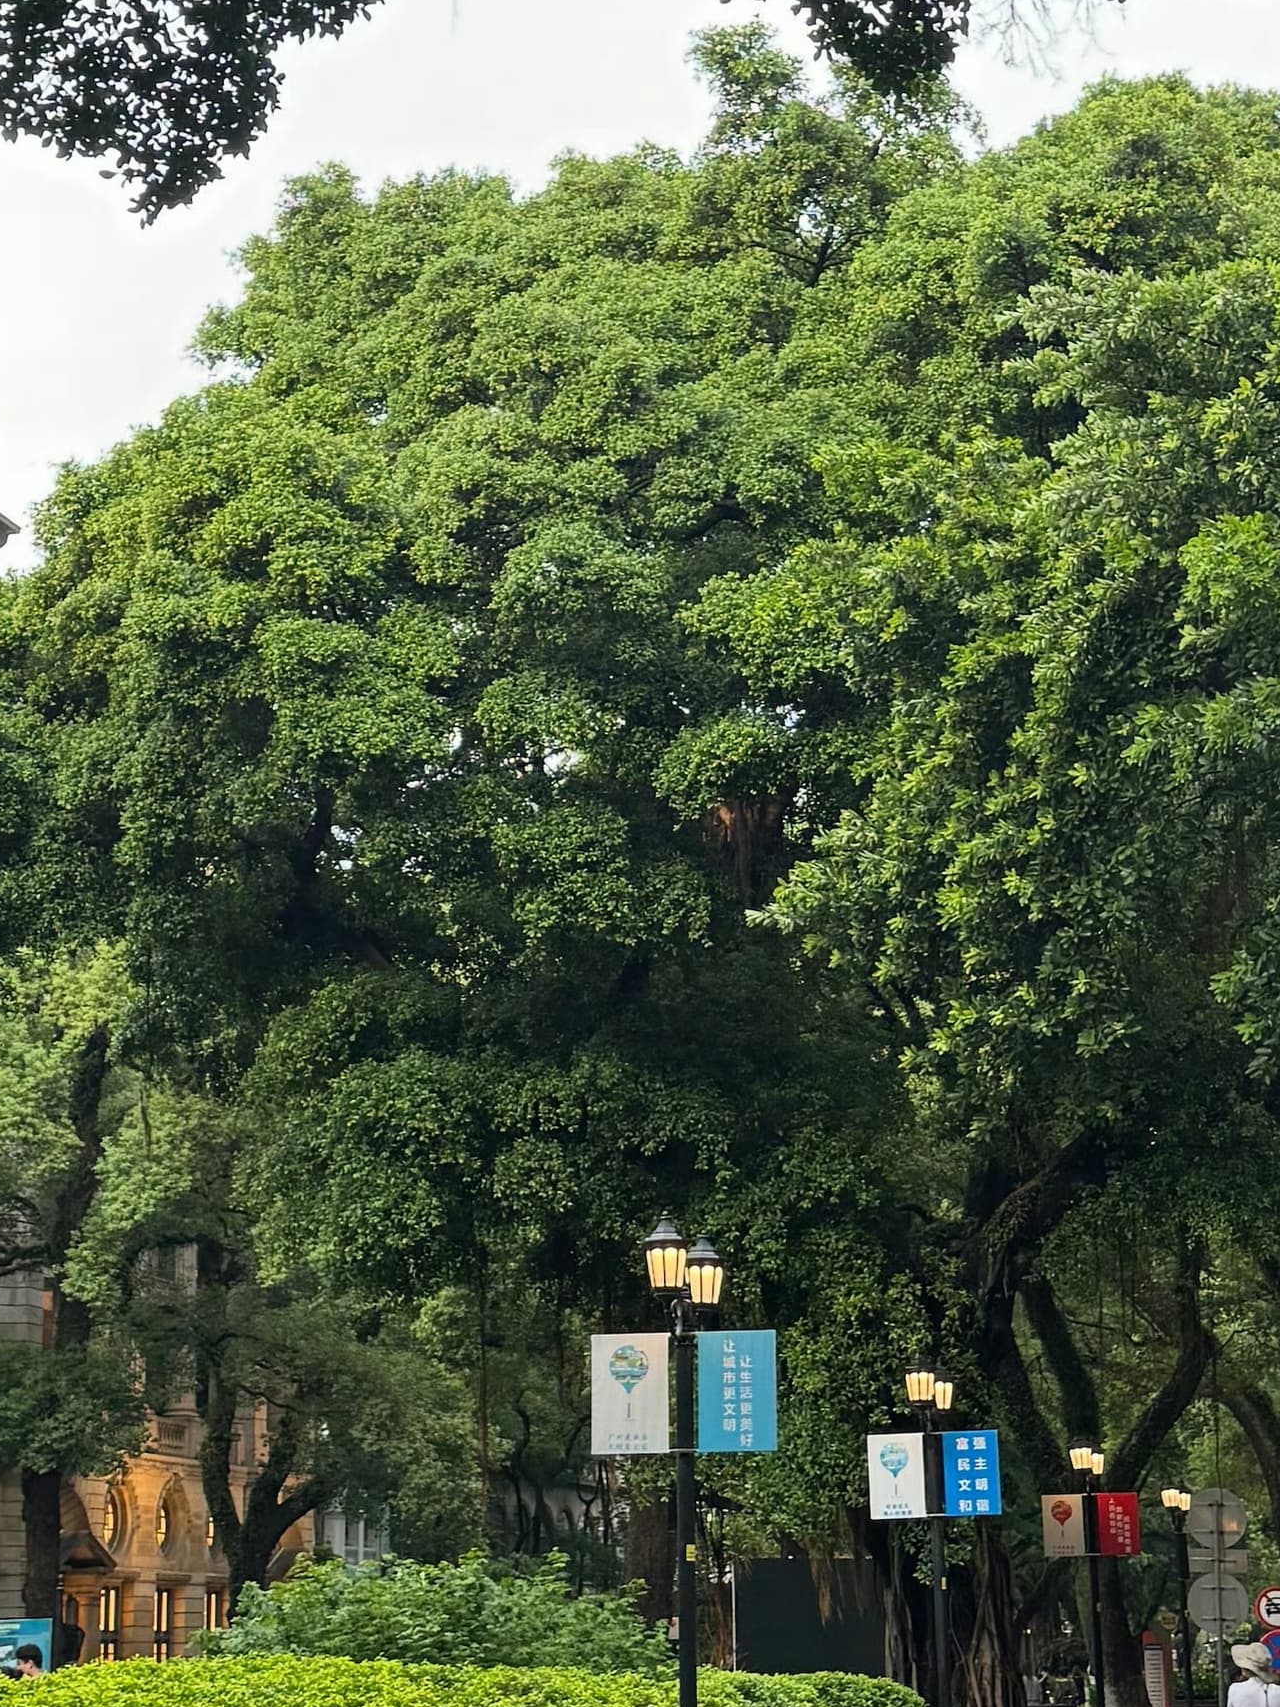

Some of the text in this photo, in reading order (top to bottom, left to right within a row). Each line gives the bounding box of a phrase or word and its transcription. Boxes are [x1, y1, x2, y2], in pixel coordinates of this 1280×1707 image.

[723, 1338, 737, 1432] 让城市更文明
[955, 1436, 987, 1450] 富强
[957, 1457, 988, 1471] 民主
[958, 1478, 989, 1492] 文明
